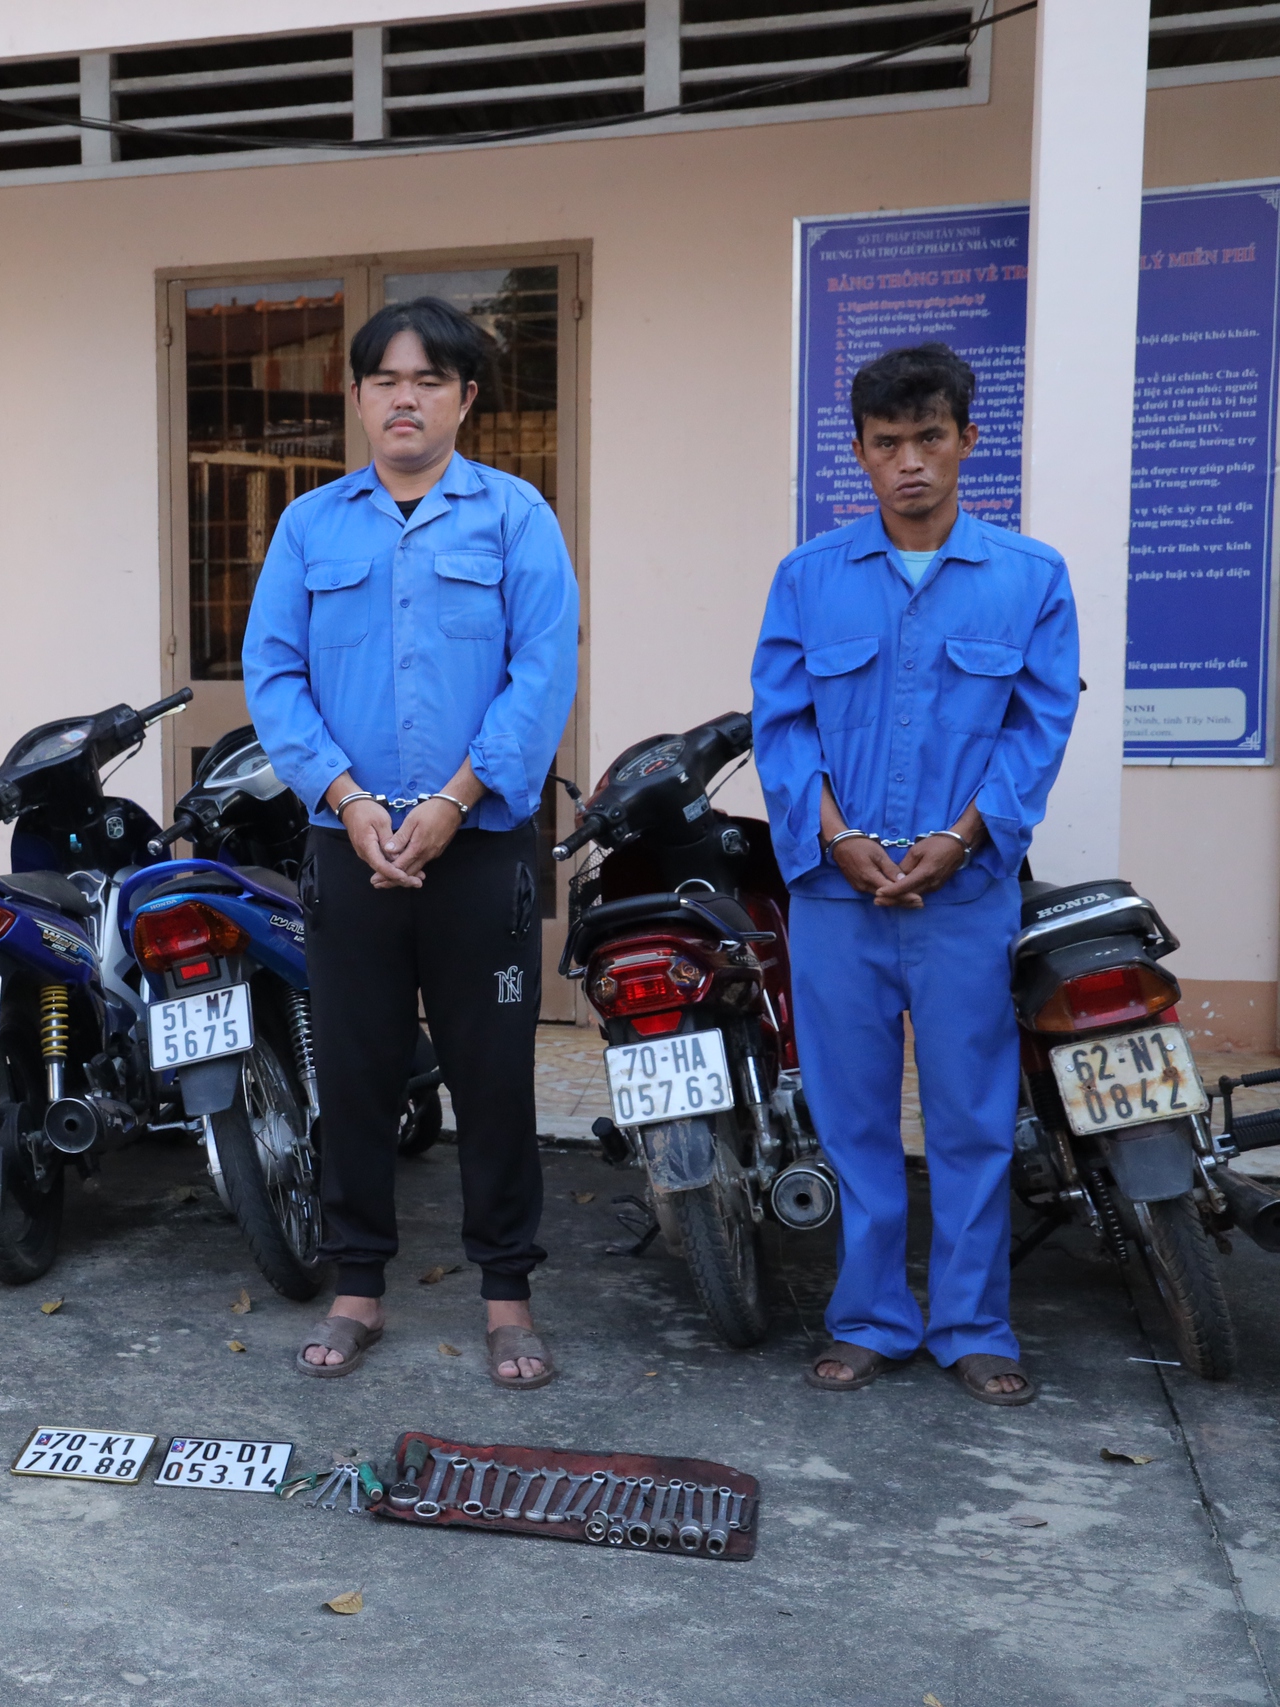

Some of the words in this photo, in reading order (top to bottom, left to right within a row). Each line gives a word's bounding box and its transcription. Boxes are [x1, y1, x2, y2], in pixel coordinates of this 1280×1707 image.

[820, 249, 853, 261] TRUNG
[855, 246, 877, 259] TÂM
[878, 245, 898, 258] TRỢ
[899, 242, 923, 255] GIÚP
[924, 239, 951, 253] PHÁP
[951, 238, 965, 251] LÝ
[967, 238, 988, 250] NHÀ
[990, 235, 1019, 248] NƯỚC
[1140, 250, 1165, 270] LÝ
[1168, 247, 1219, 268] MIỄN
[1222, 241, 1256, 264] PHÍ
[827, 273, 874, 292] BẢNG
[876, 269, 939, 289] THÔNG
[940, 269, 971, 285] TIN
[974, 262, 999, 282] VỀ
[1149, 466, 1178, 477] được
[1180, 465, 1199, 476] trợ
[1199, 463, 1225, 475] giúp
[1226, 461, 1256, 474] pháp
[1135, 571, 1163, 582] pháp
[1165, 569, 1188, 580] luật
[1190, 569, 1203, 578] và
[1205, 568, 1224, 579] đại
[1226, 567, 1250, 578] diện
[1128, 660, 1148, 670] liên
[1150, 661, 1177, 672] quan
[1179, 661, 1203, 671] trực
[1204, 657, 1226, 671] tiếp
[1227, 656, 1248, 668] đến
[150, 898, 178, 911] HONDA
[1036, 892, 1111, 919] HONDA
[270, 914, 305, 936] WAV
[51, 943, 67, 952] 100
[162, 989, 234, 1031] 51-M7
[163, 1019, 239, 1063] 5675
[622, 1037, 707, 1081] 70-HA
[1072, 1032, 1173, 1084] 62-N1
[617, 1072, 725, 1121] 057.63
[1084, 1076, 1187, 1124] 0842
[48, 1432, 137, 1456] 70-K1
[184, 1440, 273, 1465] 70-D1
[24, 1451, 137, 1477] 710.88
[163, 1461, 277, 1488] 053.14
